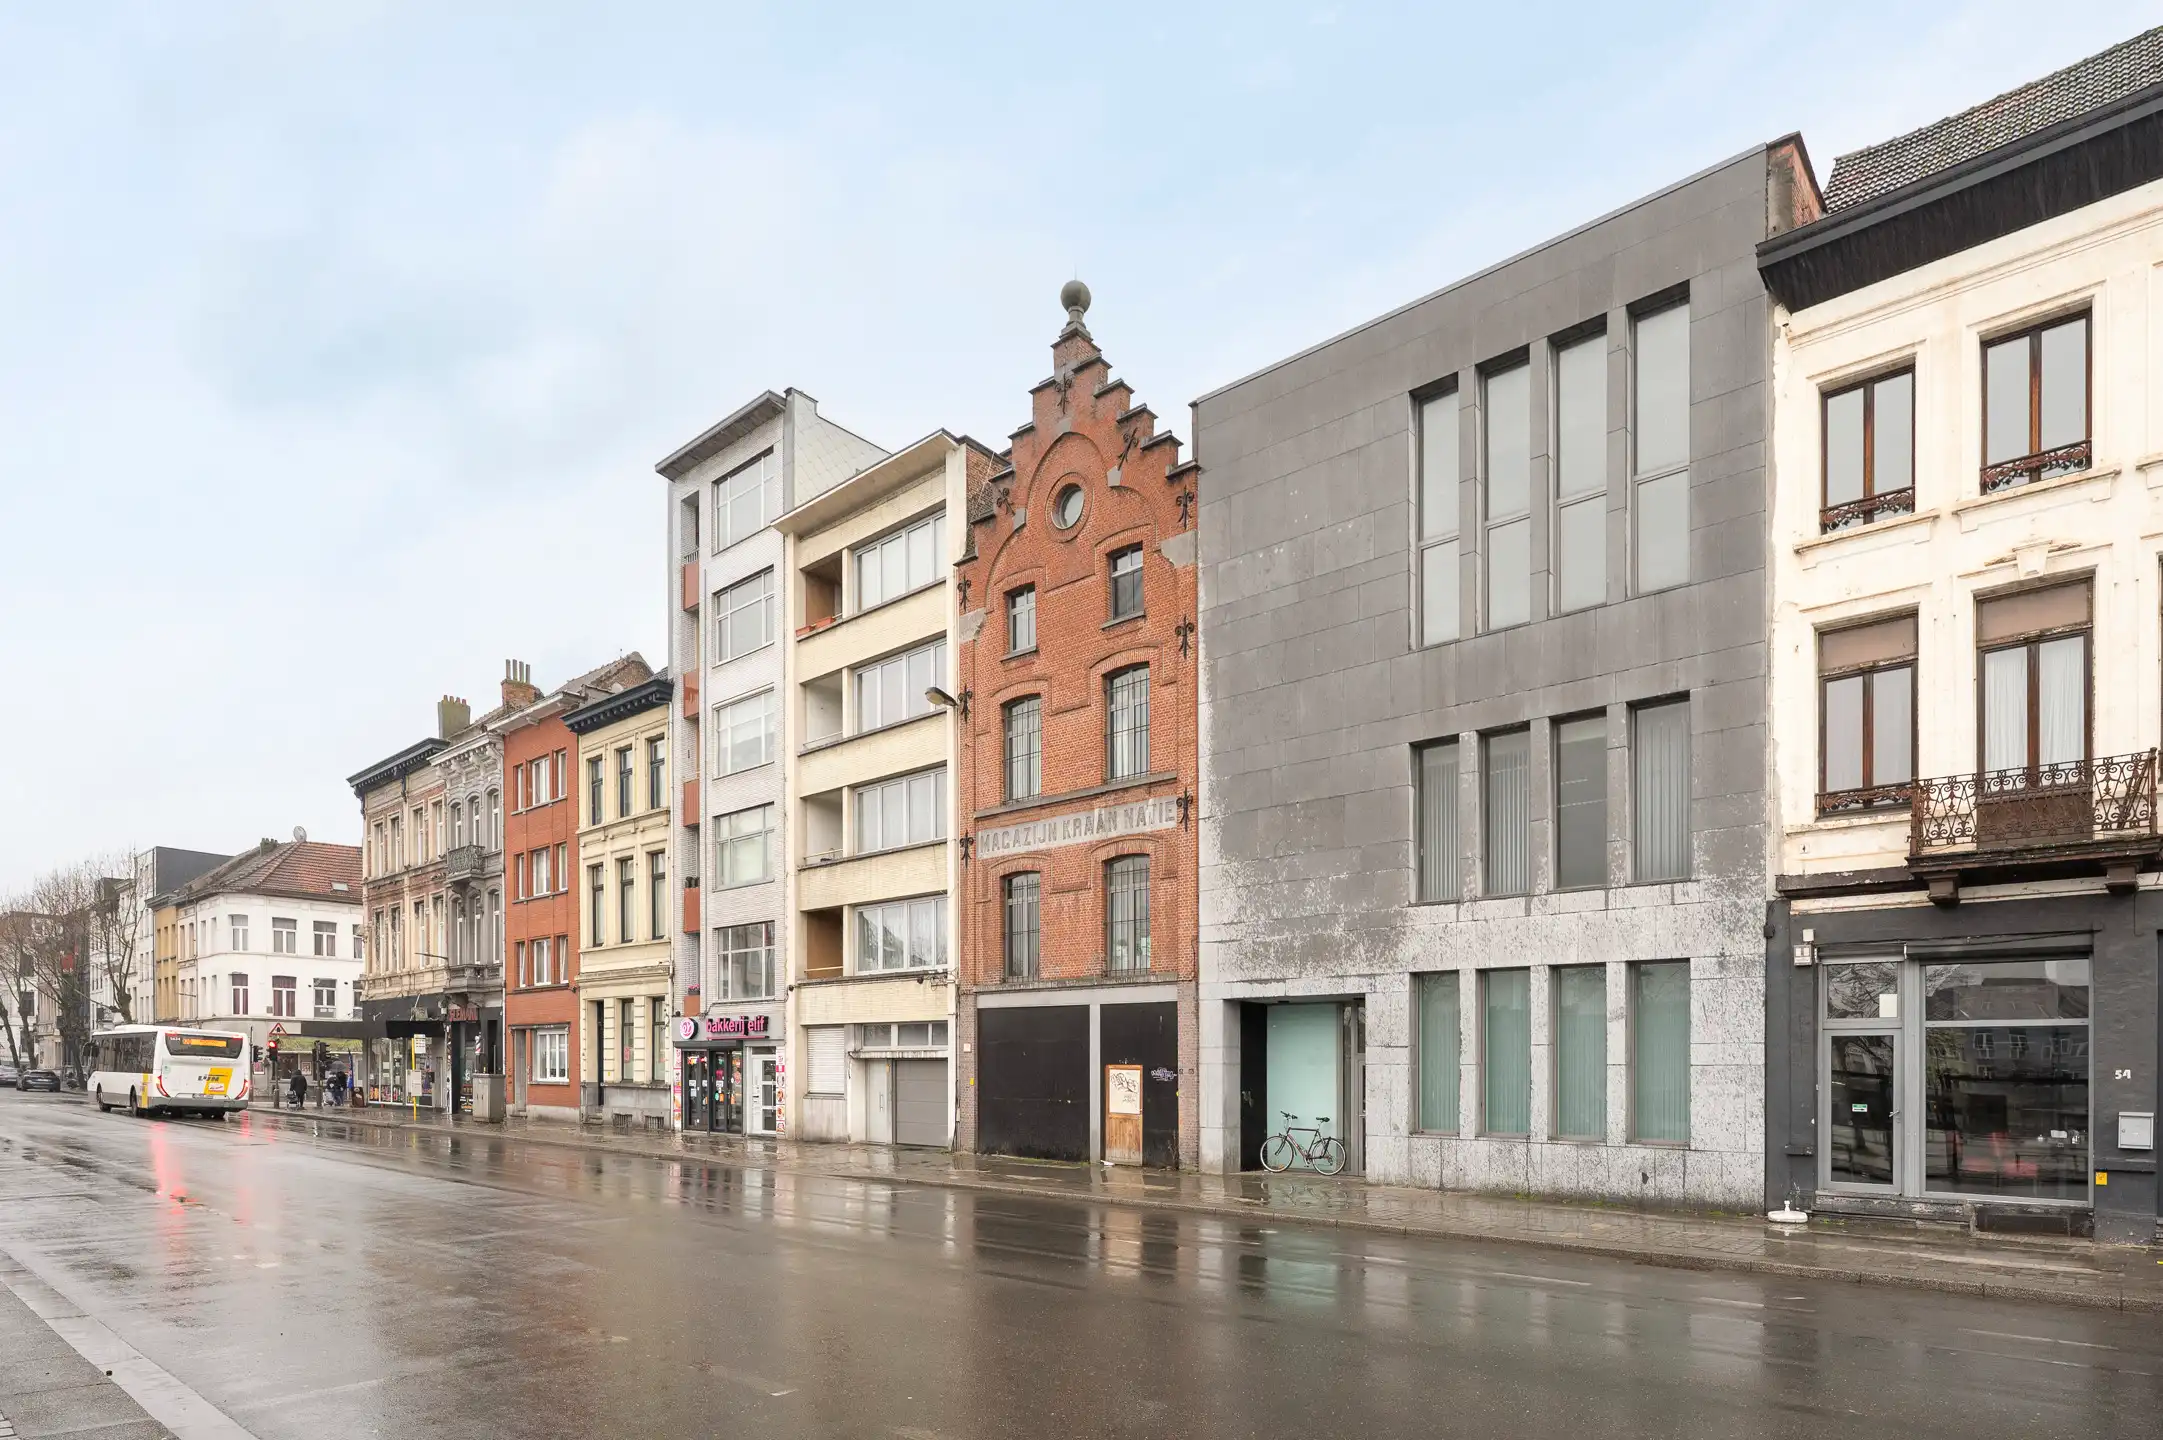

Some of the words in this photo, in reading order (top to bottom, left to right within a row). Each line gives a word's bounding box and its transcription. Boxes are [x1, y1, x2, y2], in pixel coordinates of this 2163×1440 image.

[980, 822, 1057, 854] MAGAZIJN
[1063, 811, 1118, 840] KRAAN
[705, 1015, 746, 1036] bakkerij
[747, 1015, 766, 1031] elif
[2114, 1069, 2132, 1080] 54
